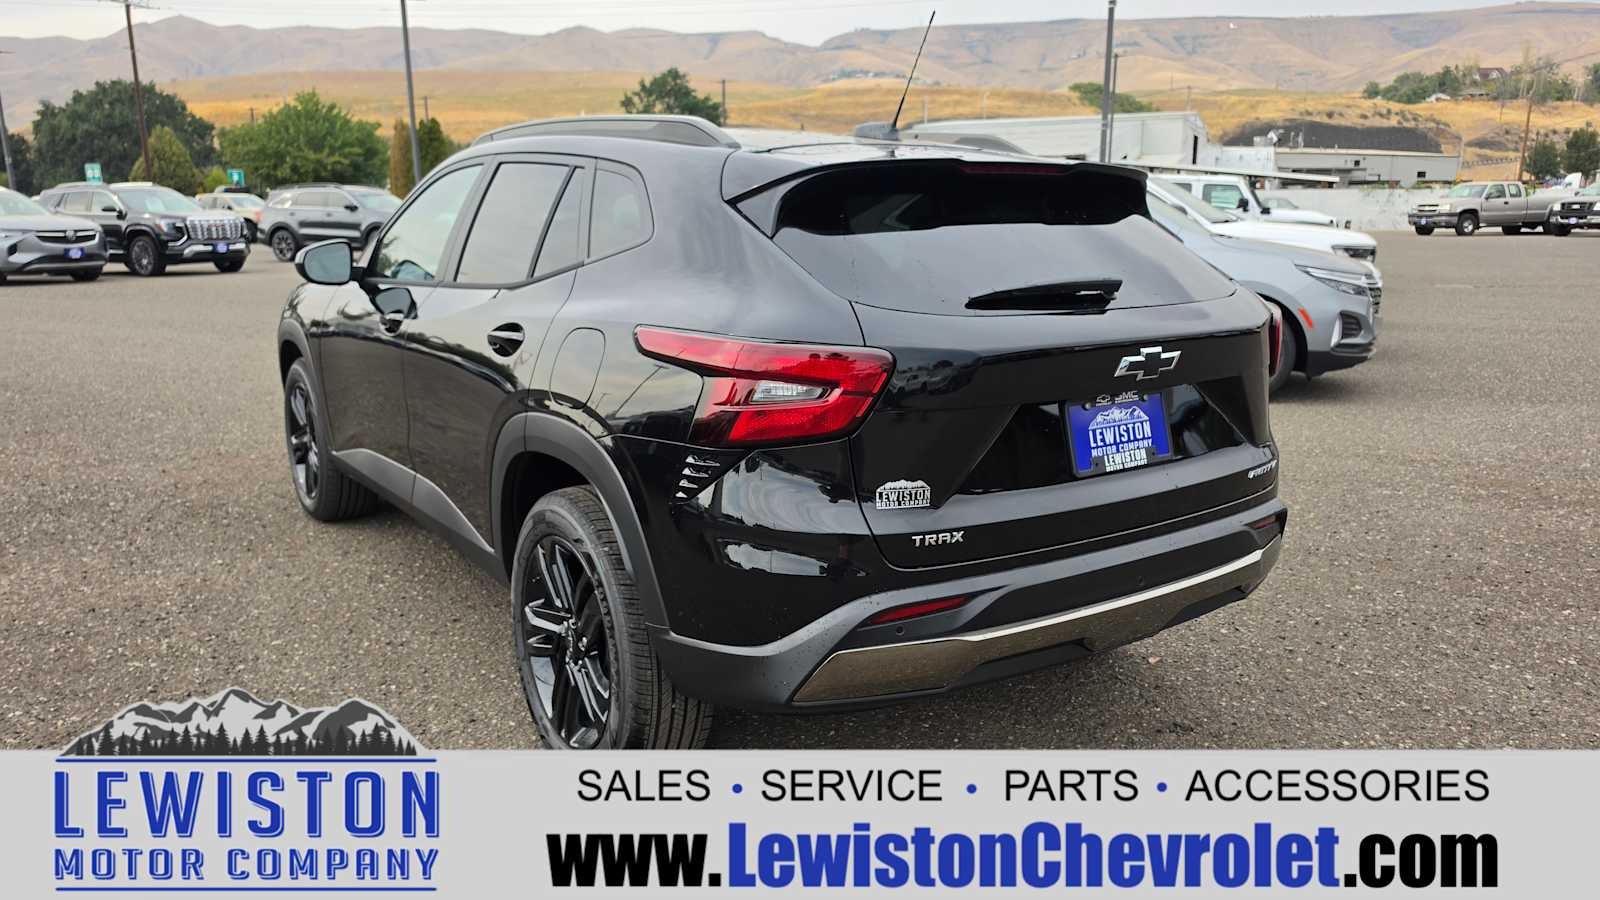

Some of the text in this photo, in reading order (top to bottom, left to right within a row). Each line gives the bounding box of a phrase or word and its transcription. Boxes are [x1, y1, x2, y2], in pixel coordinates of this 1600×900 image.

[1088, 420, 1153, 448] LEWISTON
[1091, 438, 1153, 458] MOTOR COMPANY
[1104, 448, 1147, 467] LEWISTON
[876, 490, 931, 502] LEWISTON
[901, 499, 931, 507] COMPANY
[911, 530, 965, 547] TRAX
